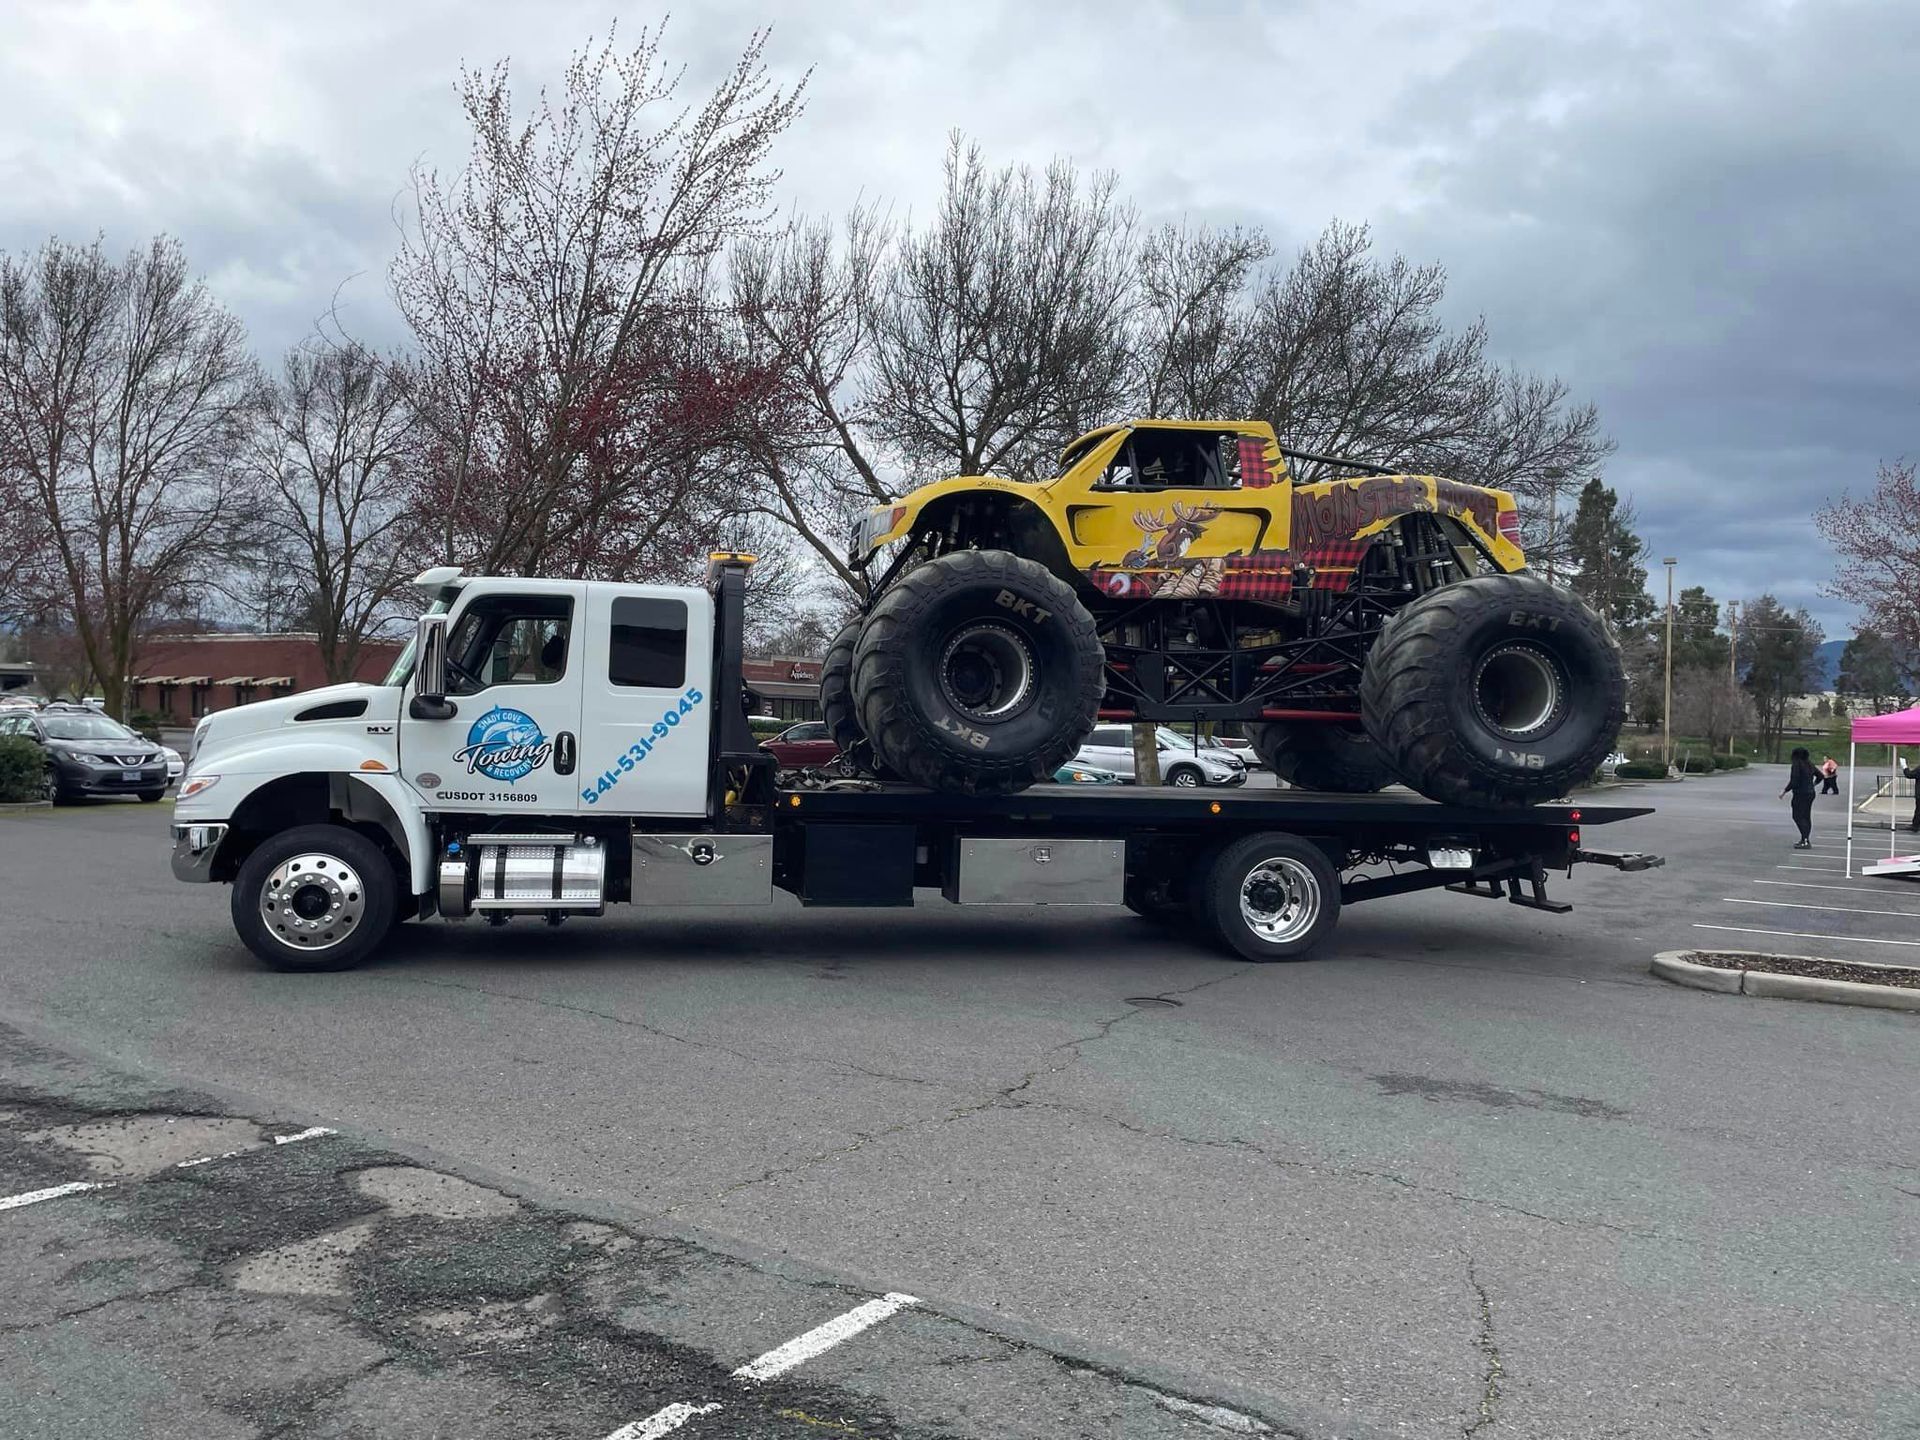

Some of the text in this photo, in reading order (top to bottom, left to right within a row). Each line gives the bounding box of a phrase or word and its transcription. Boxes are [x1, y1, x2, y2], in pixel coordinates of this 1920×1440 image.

[994, 589, 1052, 624] BKT
[477, 712, 522, 731] SHADY COVE
[933, 714, 991, 750] BKT
[453, 742, 552, 774] Towing
[581, 688, 703, 804] 541-531-9045
[488, 792, 538, 803] 3156809
